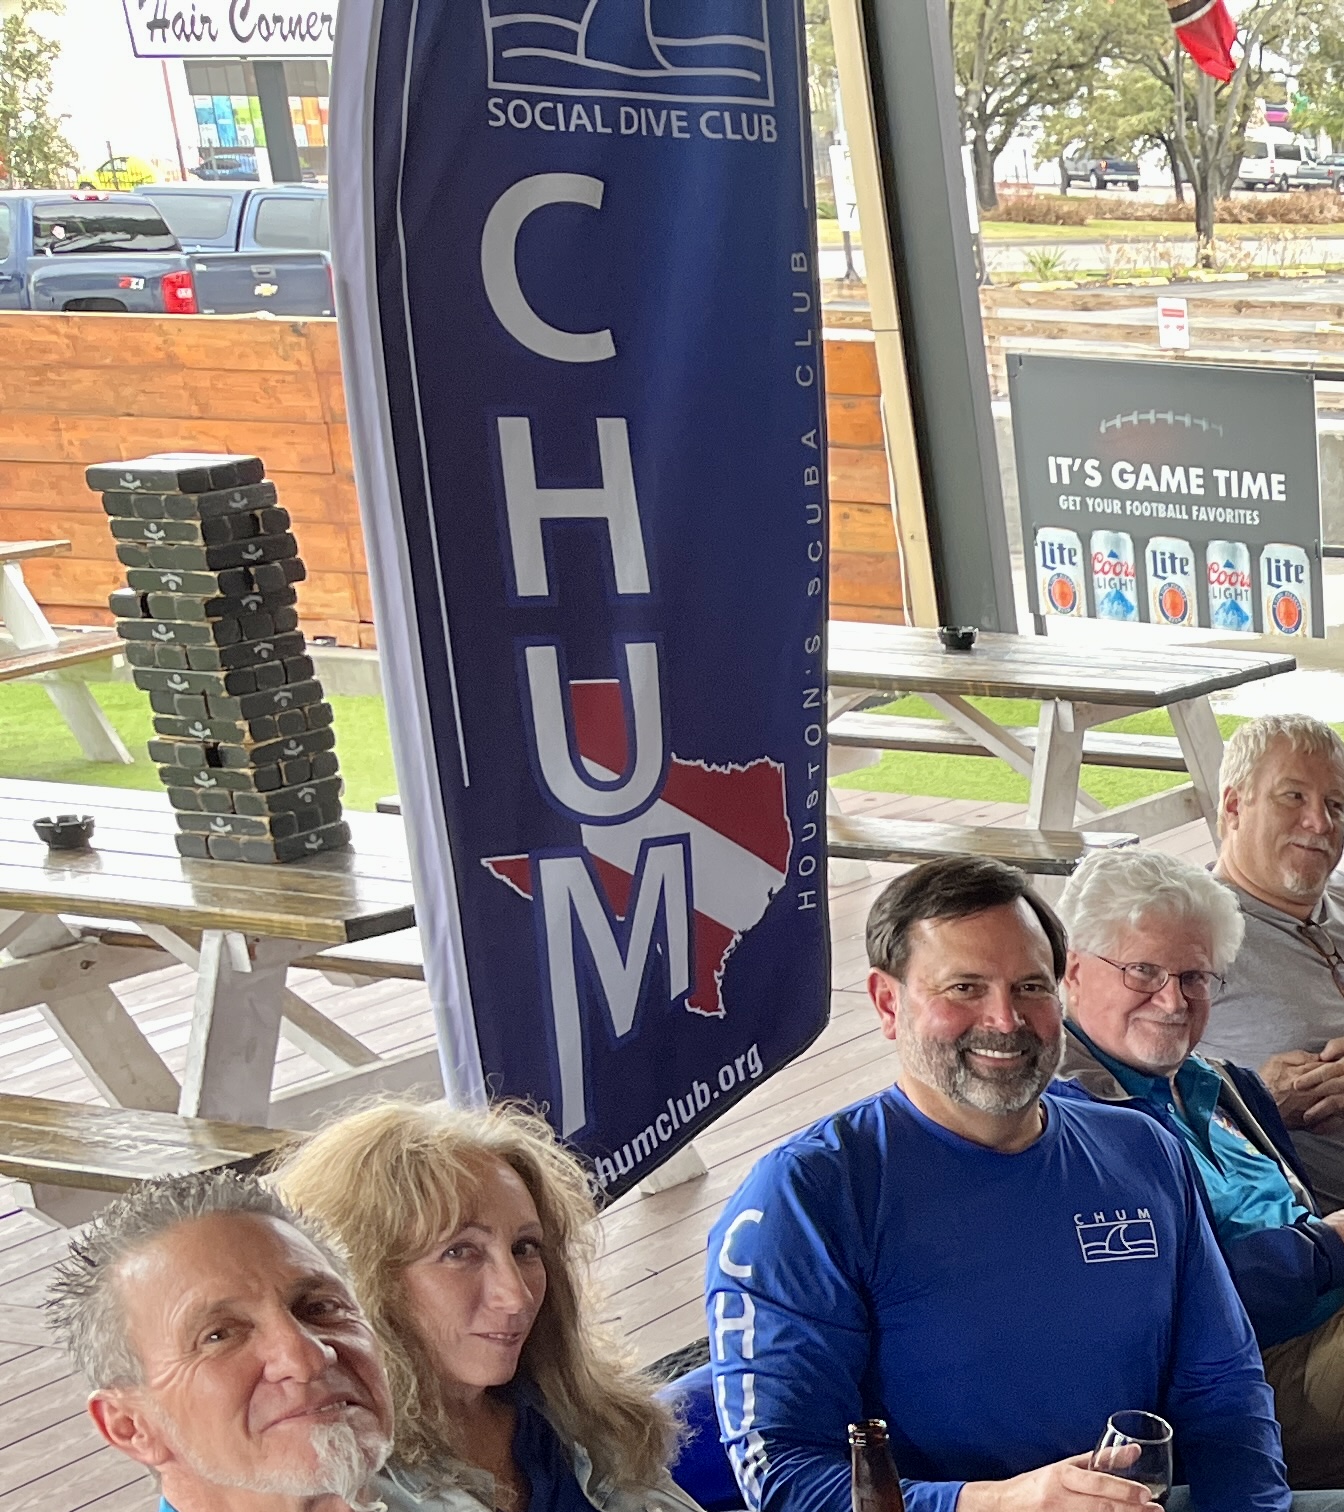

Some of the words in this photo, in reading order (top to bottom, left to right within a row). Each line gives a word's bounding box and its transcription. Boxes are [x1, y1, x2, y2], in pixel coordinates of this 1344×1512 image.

[139, 0, 218, 43] Hair
[229, 0, 335, 43] Corner
[488, 98, 612, 134] SOCIAL
[619, 107, 690, 139] DIVE
[700, 110, 778, 143] CLUB
[791, 252, 814, 387] CLUB
[1047, 455, 1103, 488] IT'S
[1111, 461, 1205, 496] GAME
[1213, 469, 1287, 501] TIME
[801, 428, 823, 596] SCUBA
[1058, 494, 1081, 511] GET
[1085, 496, 1122, 515] YOUR
[1125, 500, 1188, 520] FOOTBALL
[1191, 506, 1260, 526] FAVORITES
[1040, 540, 1077, 571] Lite
[1091, 551, 1136, 578] Coors
[1151, 549, 1190, 580] Lite
[1096, 577, 1134, 591] LIGHT
[1207, 561, 1252, 588] Coors
[1265, 557, 1304, 589] Lite
[1211, 587, 1250, 602] LIGHT
[797, 633, 823, 911] HOUSTON'S
[1073, 1207, 1152, 1226] CHUM
